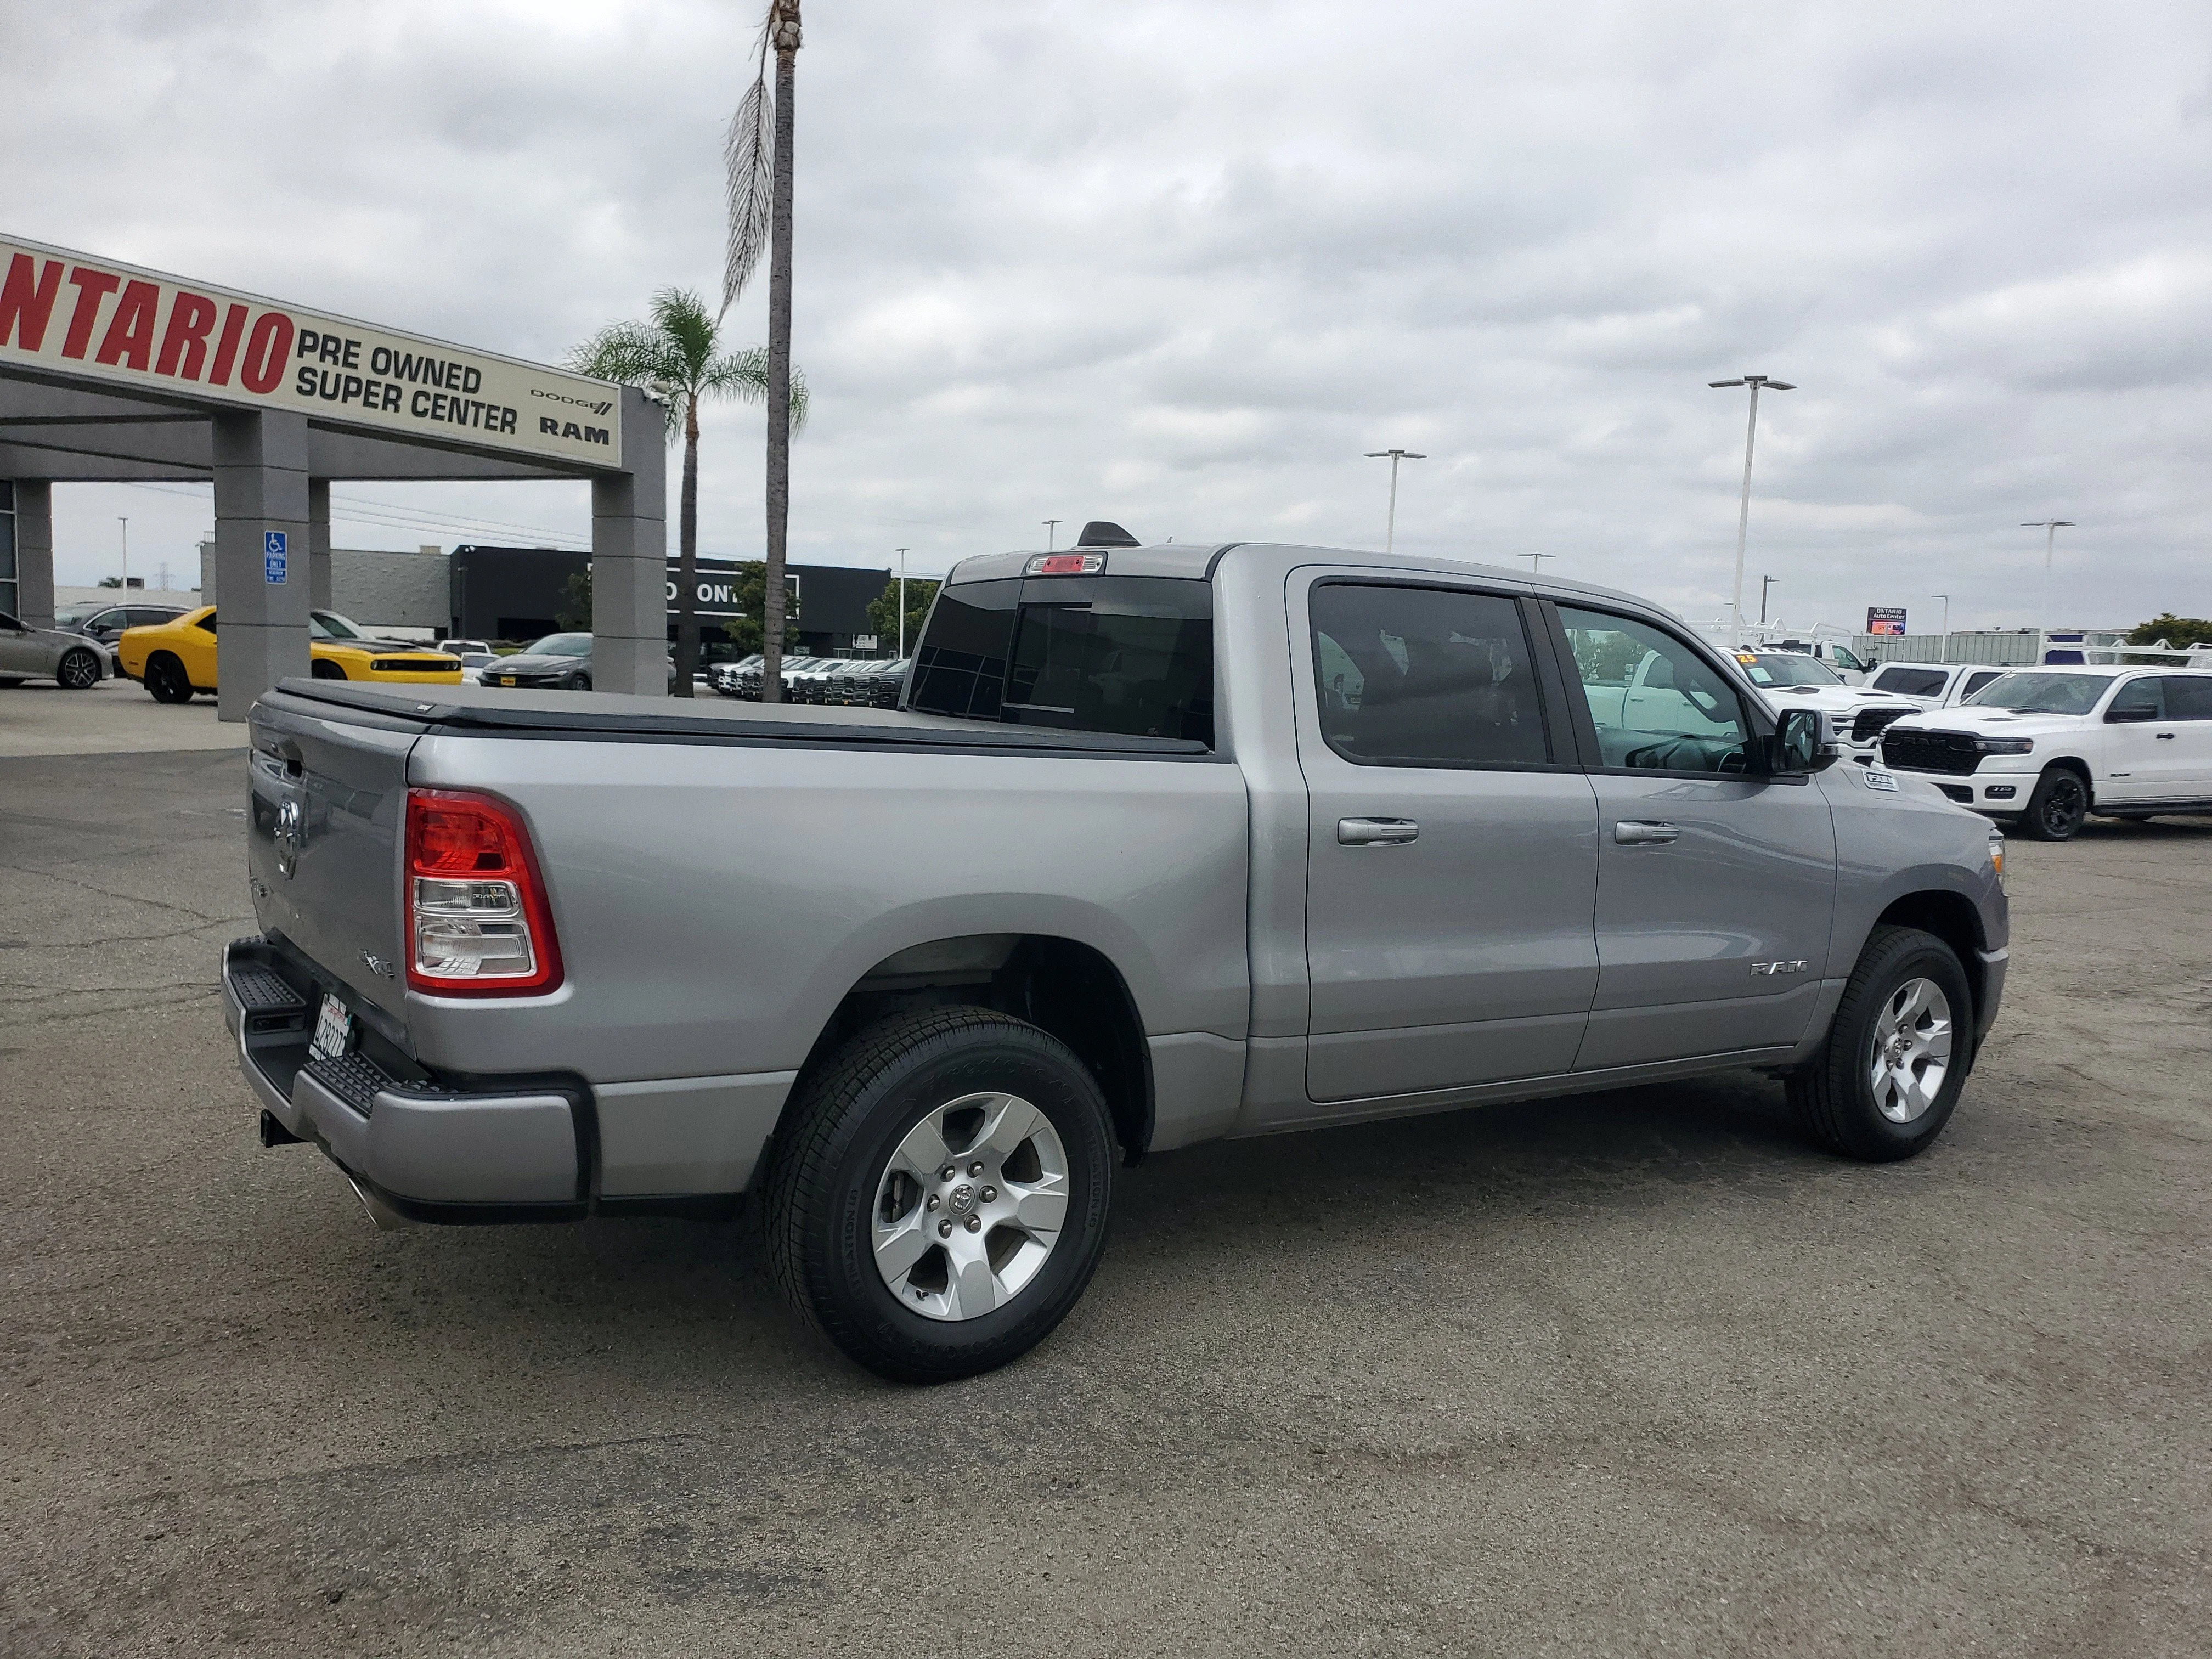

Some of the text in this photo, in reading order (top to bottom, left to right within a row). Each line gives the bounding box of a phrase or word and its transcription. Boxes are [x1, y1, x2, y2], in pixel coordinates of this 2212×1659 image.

[297, 329, 481, 394] PRE OWNED
[296, 366, 517, 435] SUPER CENTER
[531, 389, 603, 411] DODGE
[540, 416, 610, 445] RAM
[1736, 654, 1757, 663] 25
[1750, 960, 1808, 975] RAM
